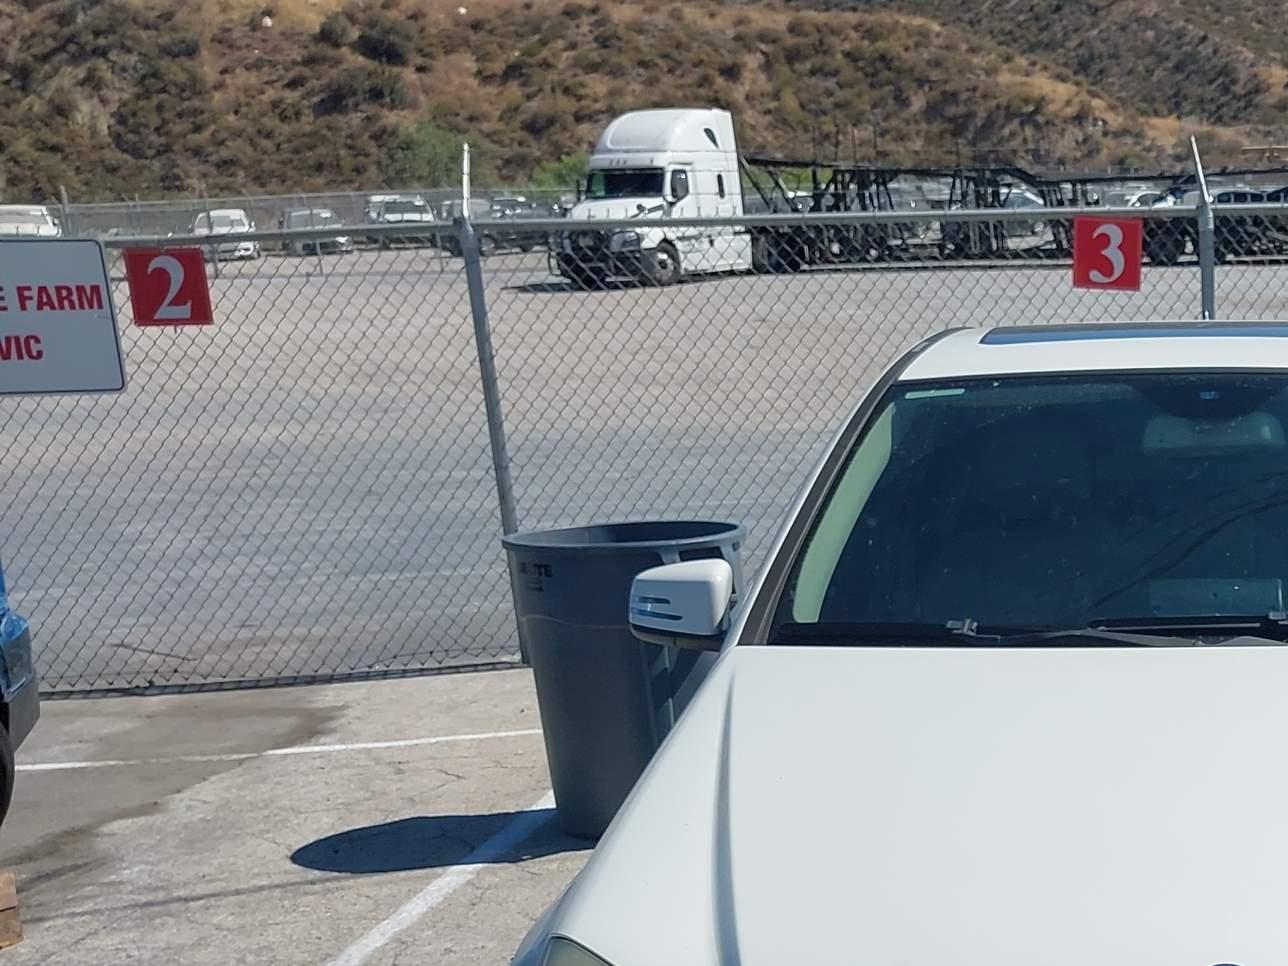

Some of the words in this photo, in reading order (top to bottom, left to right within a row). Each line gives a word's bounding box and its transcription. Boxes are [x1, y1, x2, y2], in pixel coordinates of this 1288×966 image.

[1088, 223, 1125, 284] 3
[16, 284, 104, 311] FARM
[146, 255, 192, 320] 2
